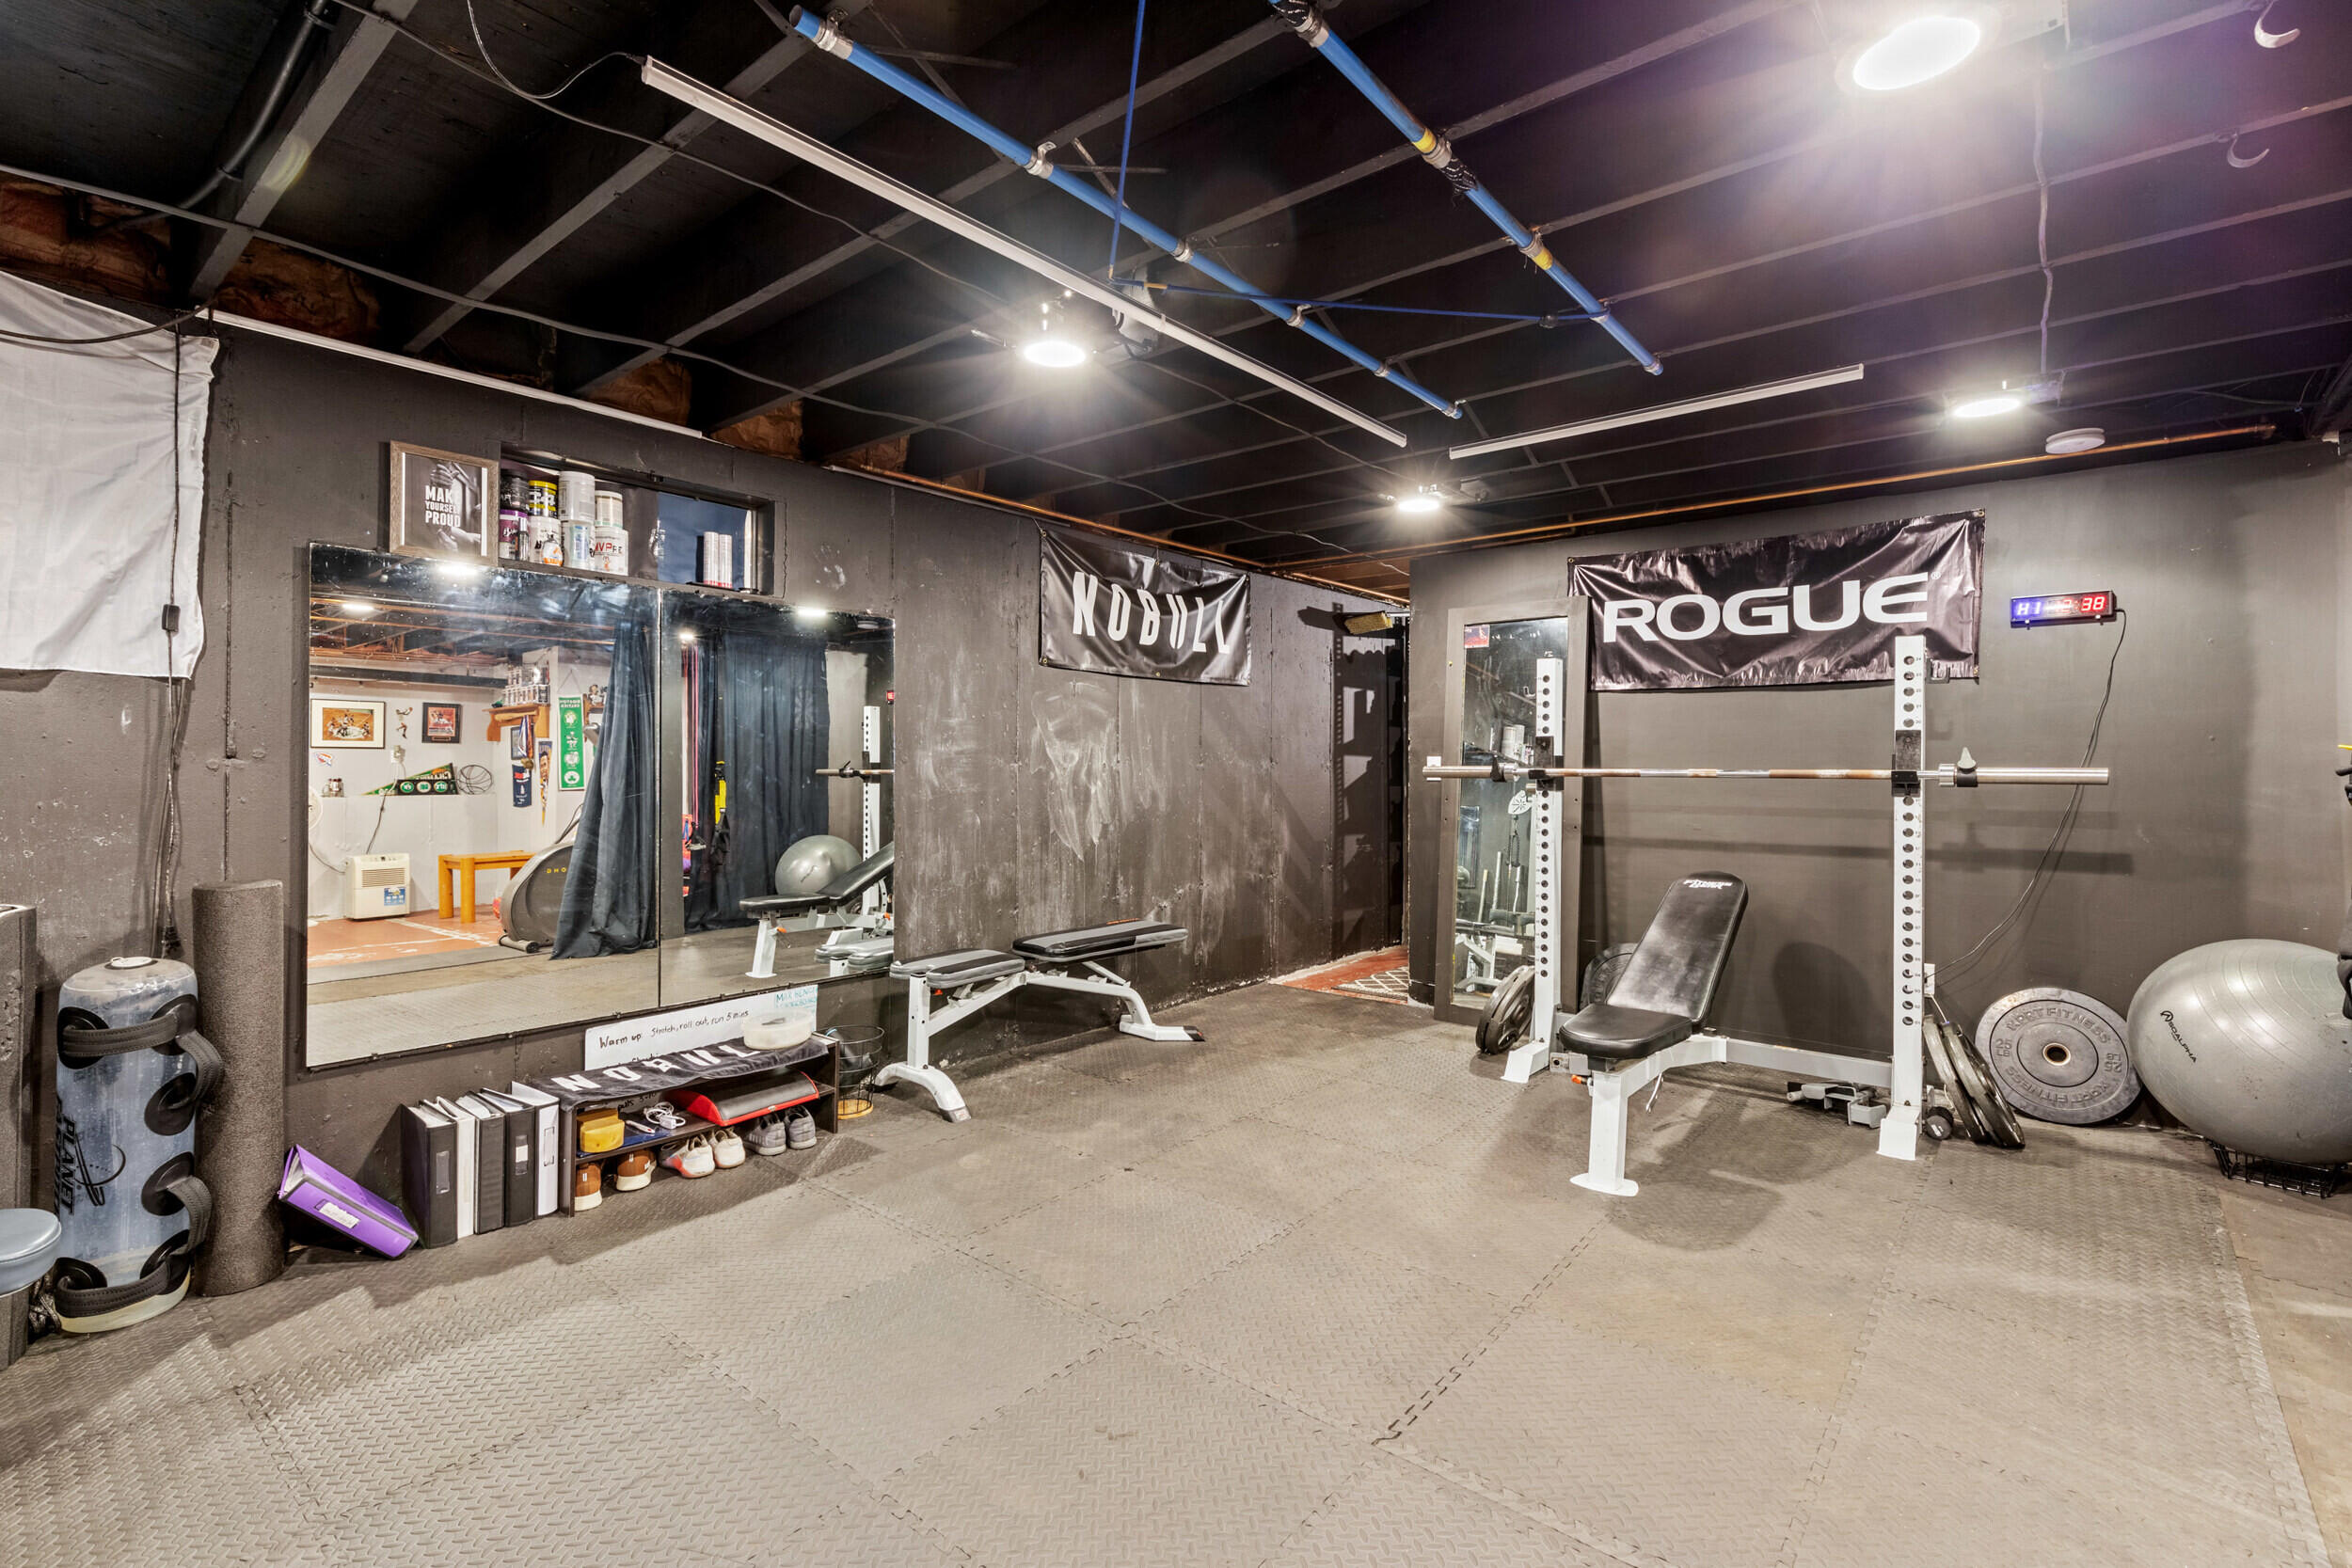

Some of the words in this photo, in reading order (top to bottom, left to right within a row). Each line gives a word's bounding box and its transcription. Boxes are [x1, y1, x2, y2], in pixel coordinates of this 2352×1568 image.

[425, 484, 454, 503] MAK
[425, 500, 460, 515] YOURSEL
[425, 511, 461, 528] PROUD
[1073, 572, 1231, 654] NOBULL
[1602, 572, 1929, 643] ROGUE
[599, 1036, 628, 1049] Warm
[631, 1033, 642, 1042] up
[679, 1021, 692, 1030] roll
[711, 1016, 724, 1024] run
[1995, 1038, 2012, 1050] 25
[60, 1116, 76, 1215] PLANET
